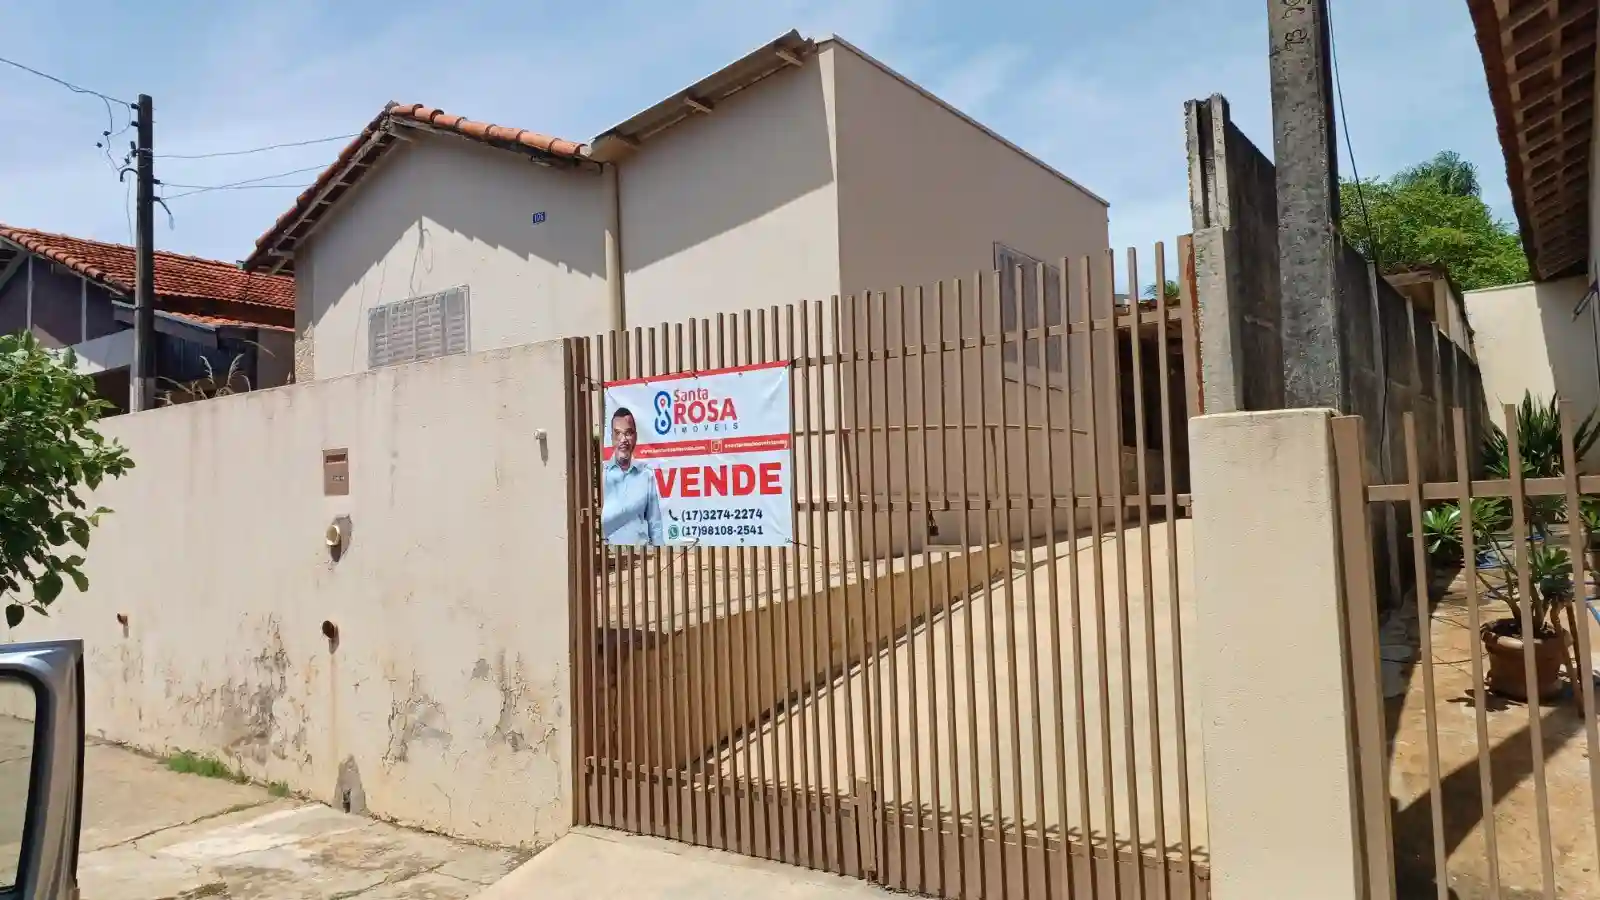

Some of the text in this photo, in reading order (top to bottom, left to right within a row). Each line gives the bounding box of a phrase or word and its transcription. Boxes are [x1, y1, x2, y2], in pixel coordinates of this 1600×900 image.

[674, 388, 709, 402] Santa
[674, 398, 737, 424] ROSA
[654, 462, 783, 498] VENDE
[681, 508, 763, 522] (17)3274-2274
[681, 525, 763, 538] (17)98108-2541
